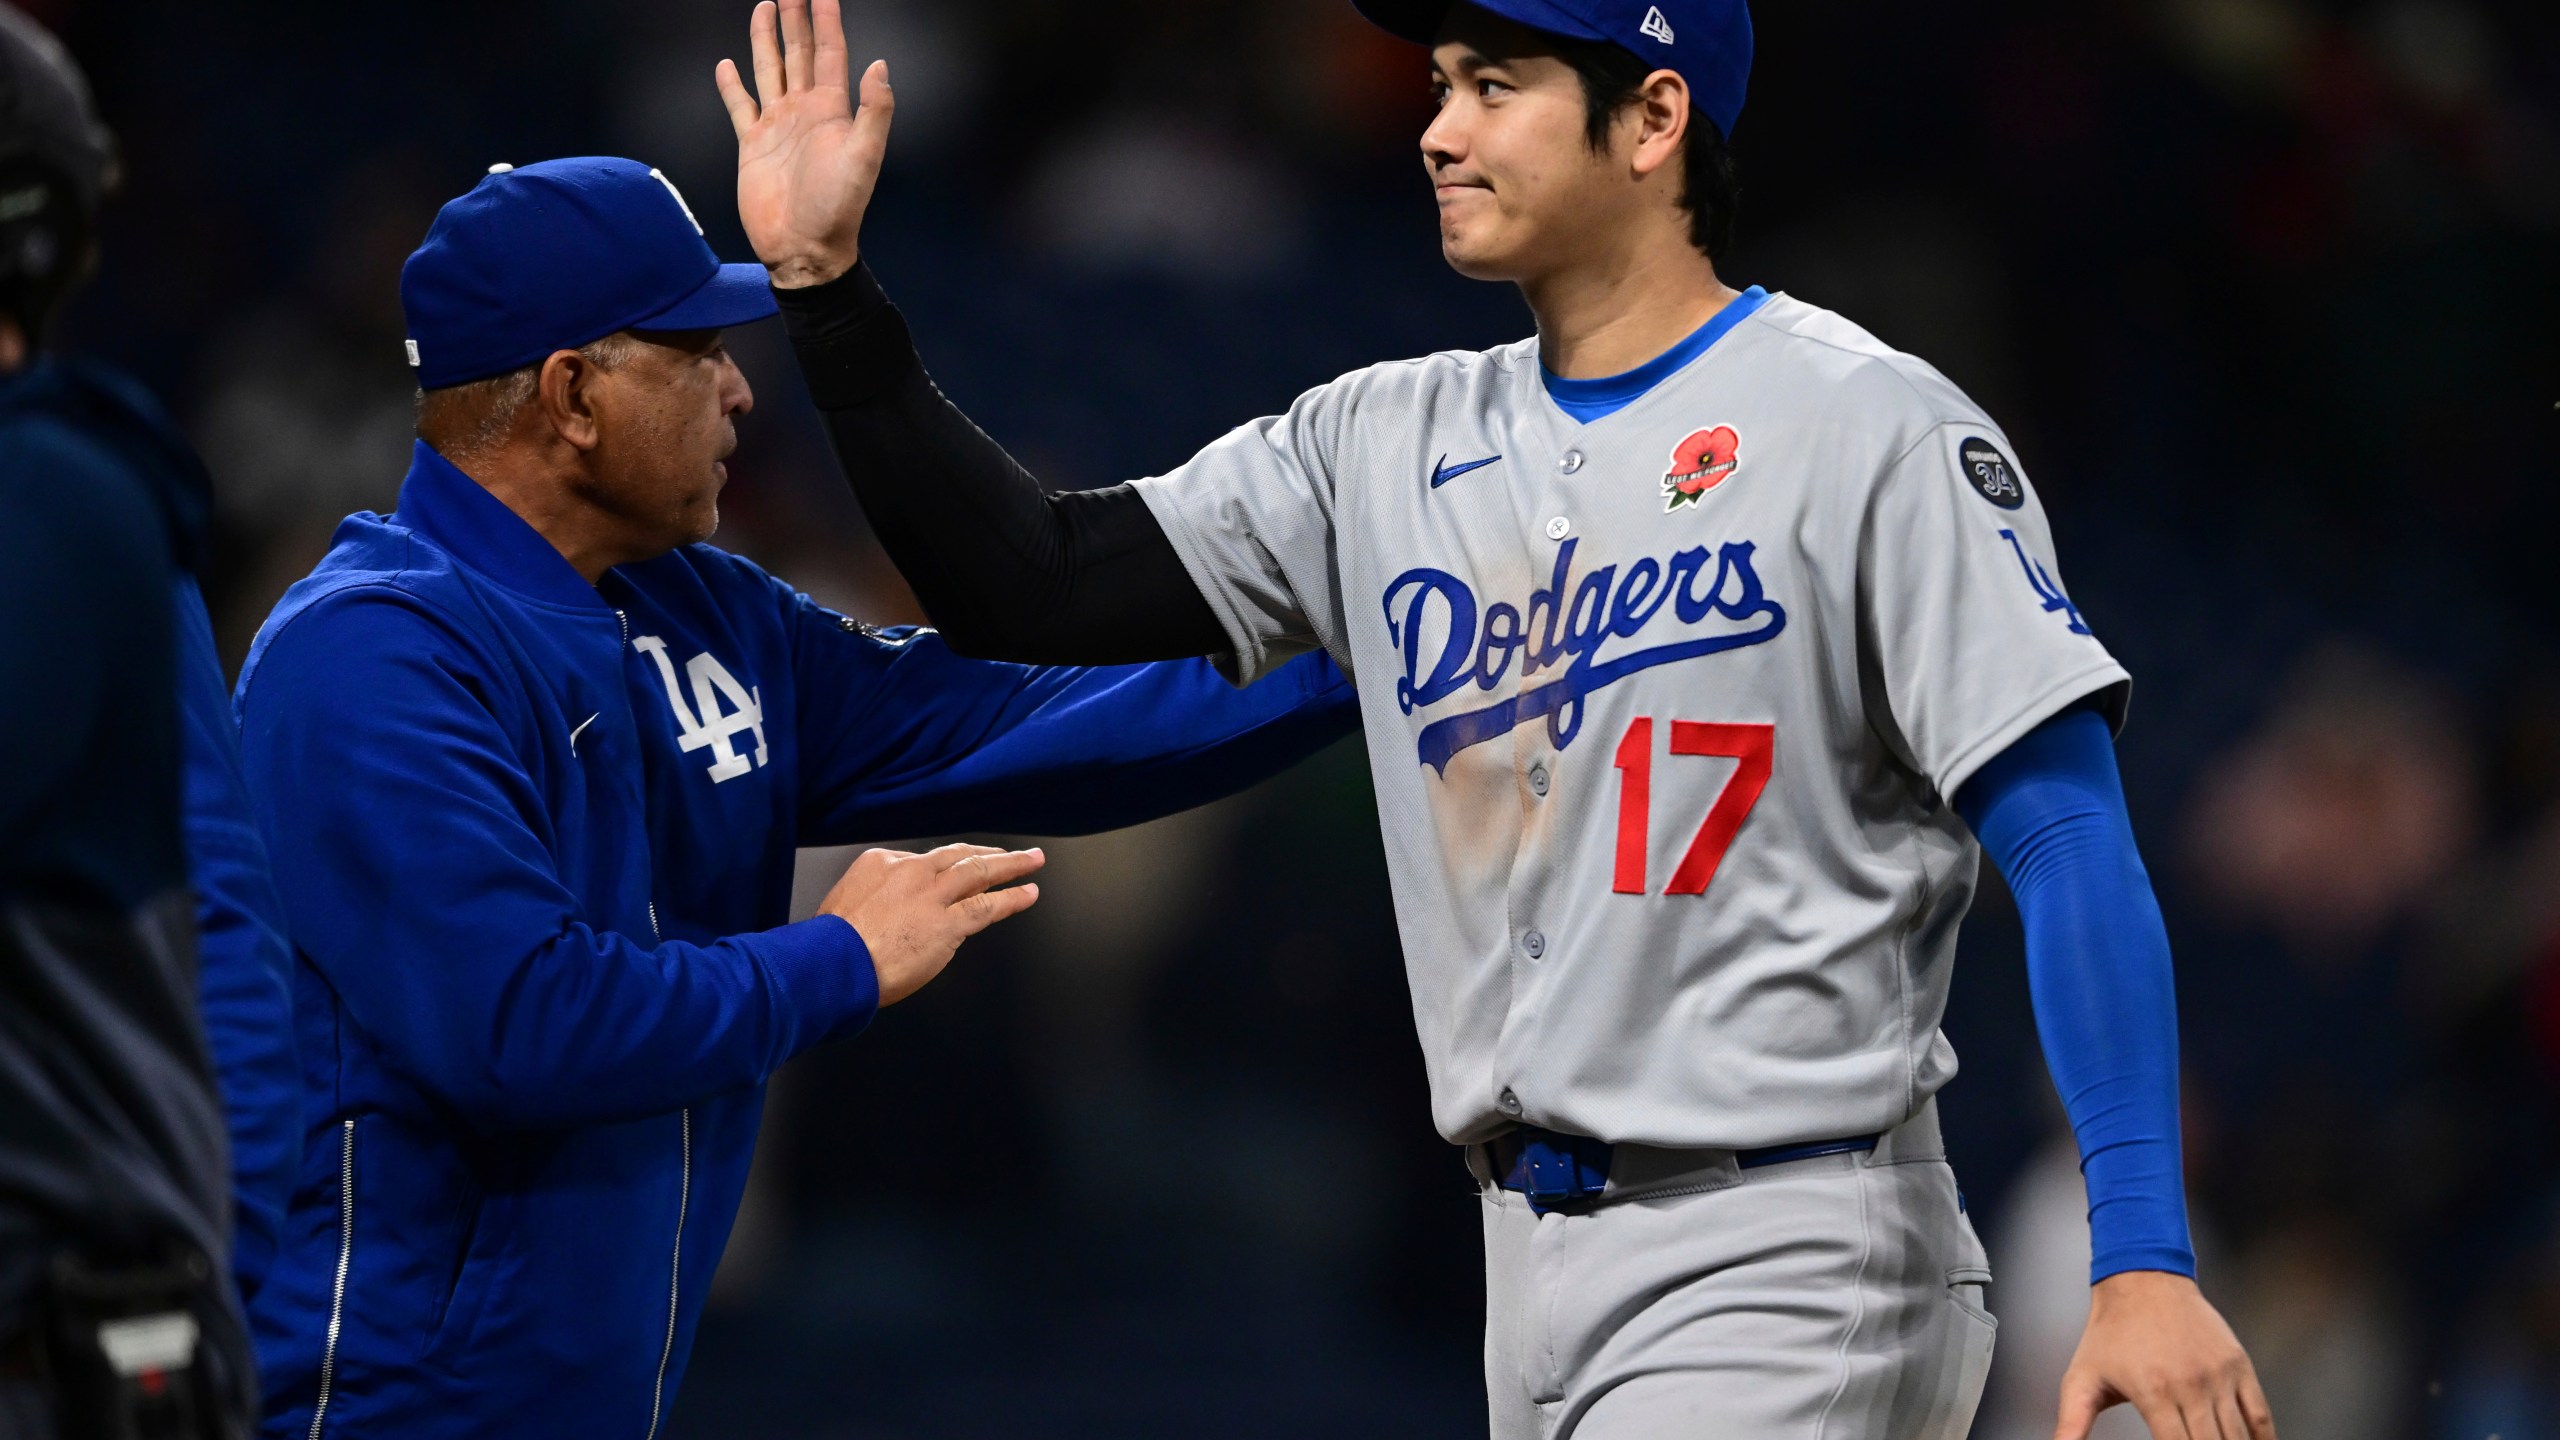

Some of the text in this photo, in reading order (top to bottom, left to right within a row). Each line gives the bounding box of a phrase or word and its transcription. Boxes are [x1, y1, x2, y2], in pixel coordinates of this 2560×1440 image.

[1975, 463, 2018, 497] 34
[632, 635, 768, 784] LA
[1383, 537, 1786, 780] Dodgers
[1612, 716, 1775, 895] 17
